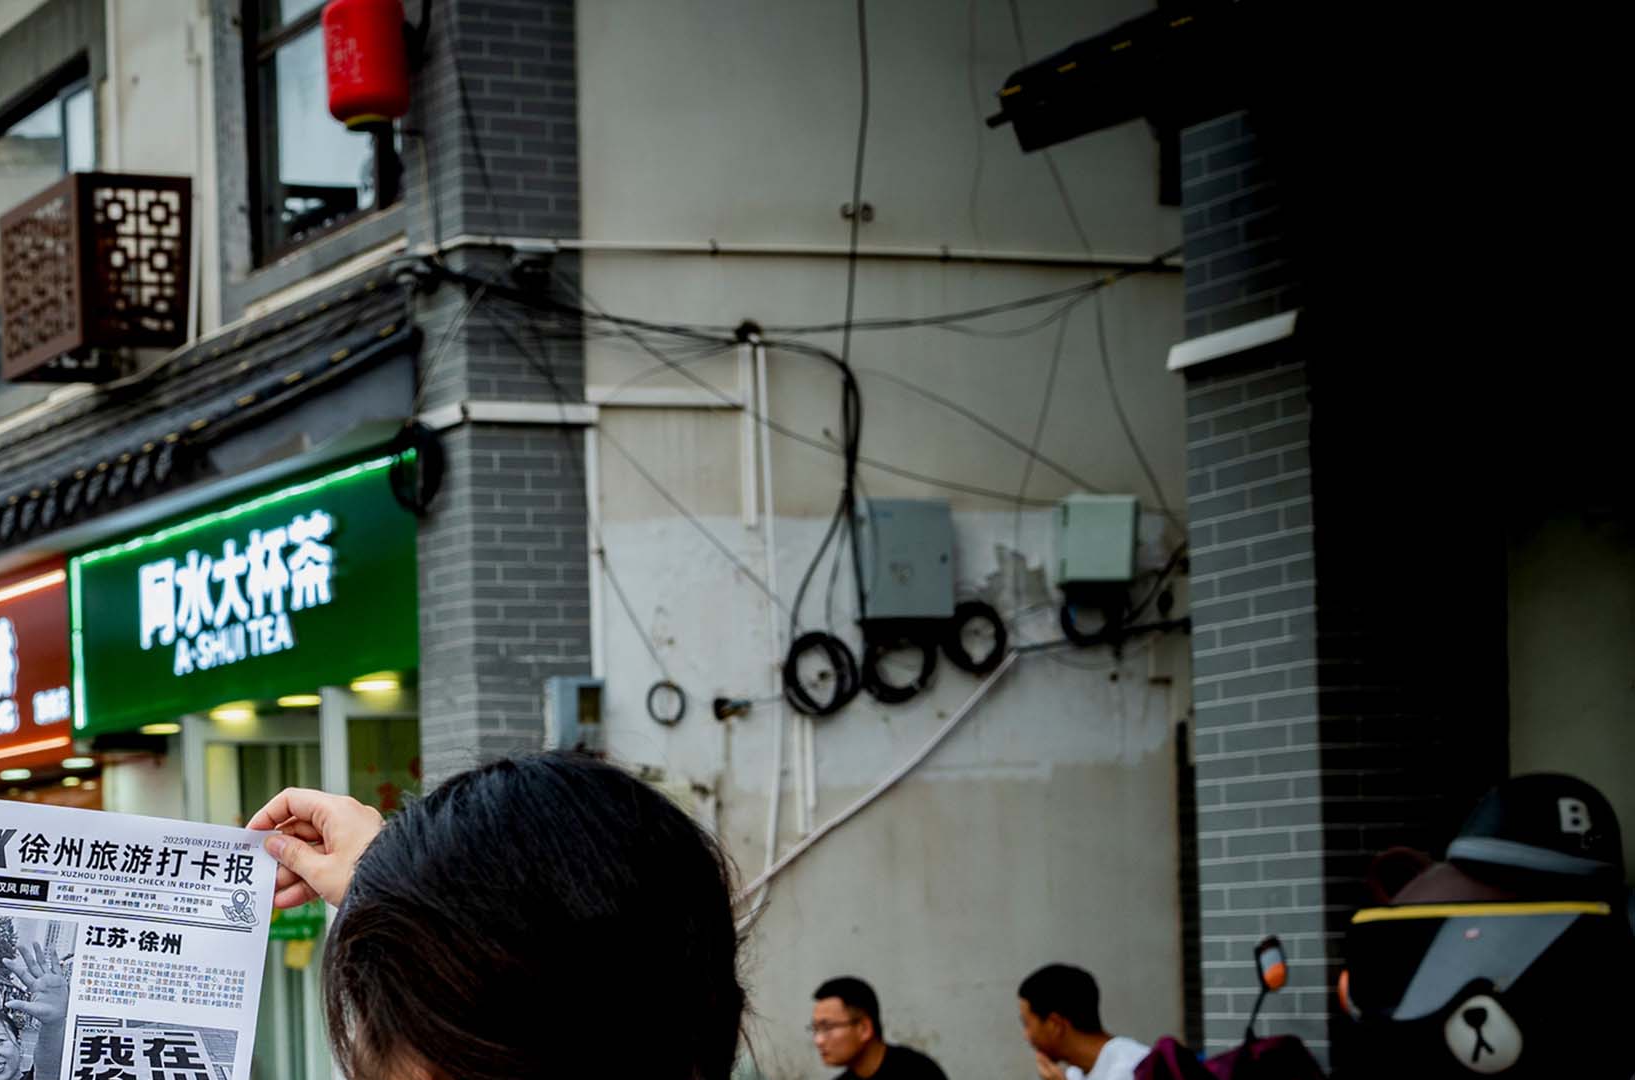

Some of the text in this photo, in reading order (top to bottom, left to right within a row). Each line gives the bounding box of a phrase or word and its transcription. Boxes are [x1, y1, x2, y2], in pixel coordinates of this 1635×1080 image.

[247, 612, 294, 657] TEA
[163, 835, 231, 850] 2025年08月25日
[18, 832, 255, 886] 徐州旅游打卡报
[60, 869, 212, 892] XUZHOU TOURISM CHECK IN REPORT
[85, 925, 183, 956] 江苏·徐州
